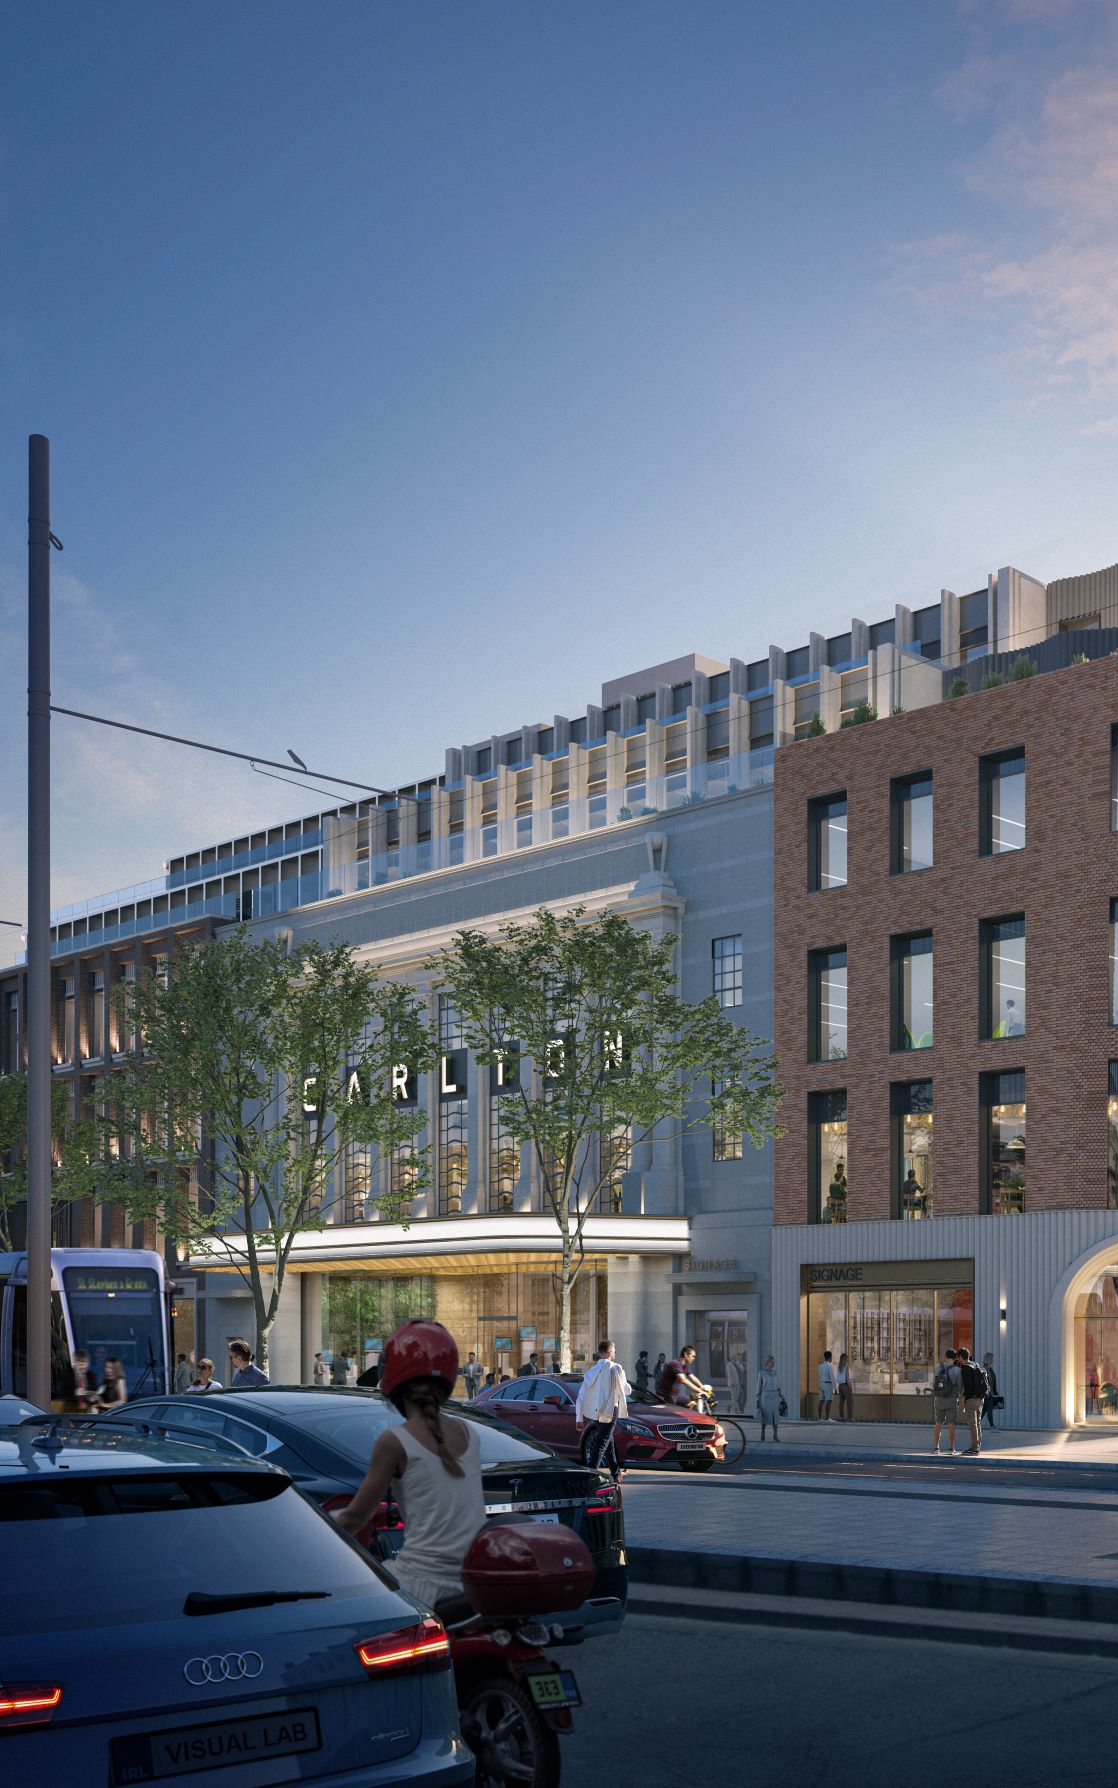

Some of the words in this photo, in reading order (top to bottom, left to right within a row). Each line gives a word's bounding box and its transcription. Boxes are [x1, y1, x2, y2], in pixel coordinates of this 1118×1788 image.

[809, 1267, 863, 1282] SIGNAGE
[164, 1731, 257, 1764] VISUAL
[263, 1723, 308, 1747] LAB
[122, 1765, 149, 1781] IRL
